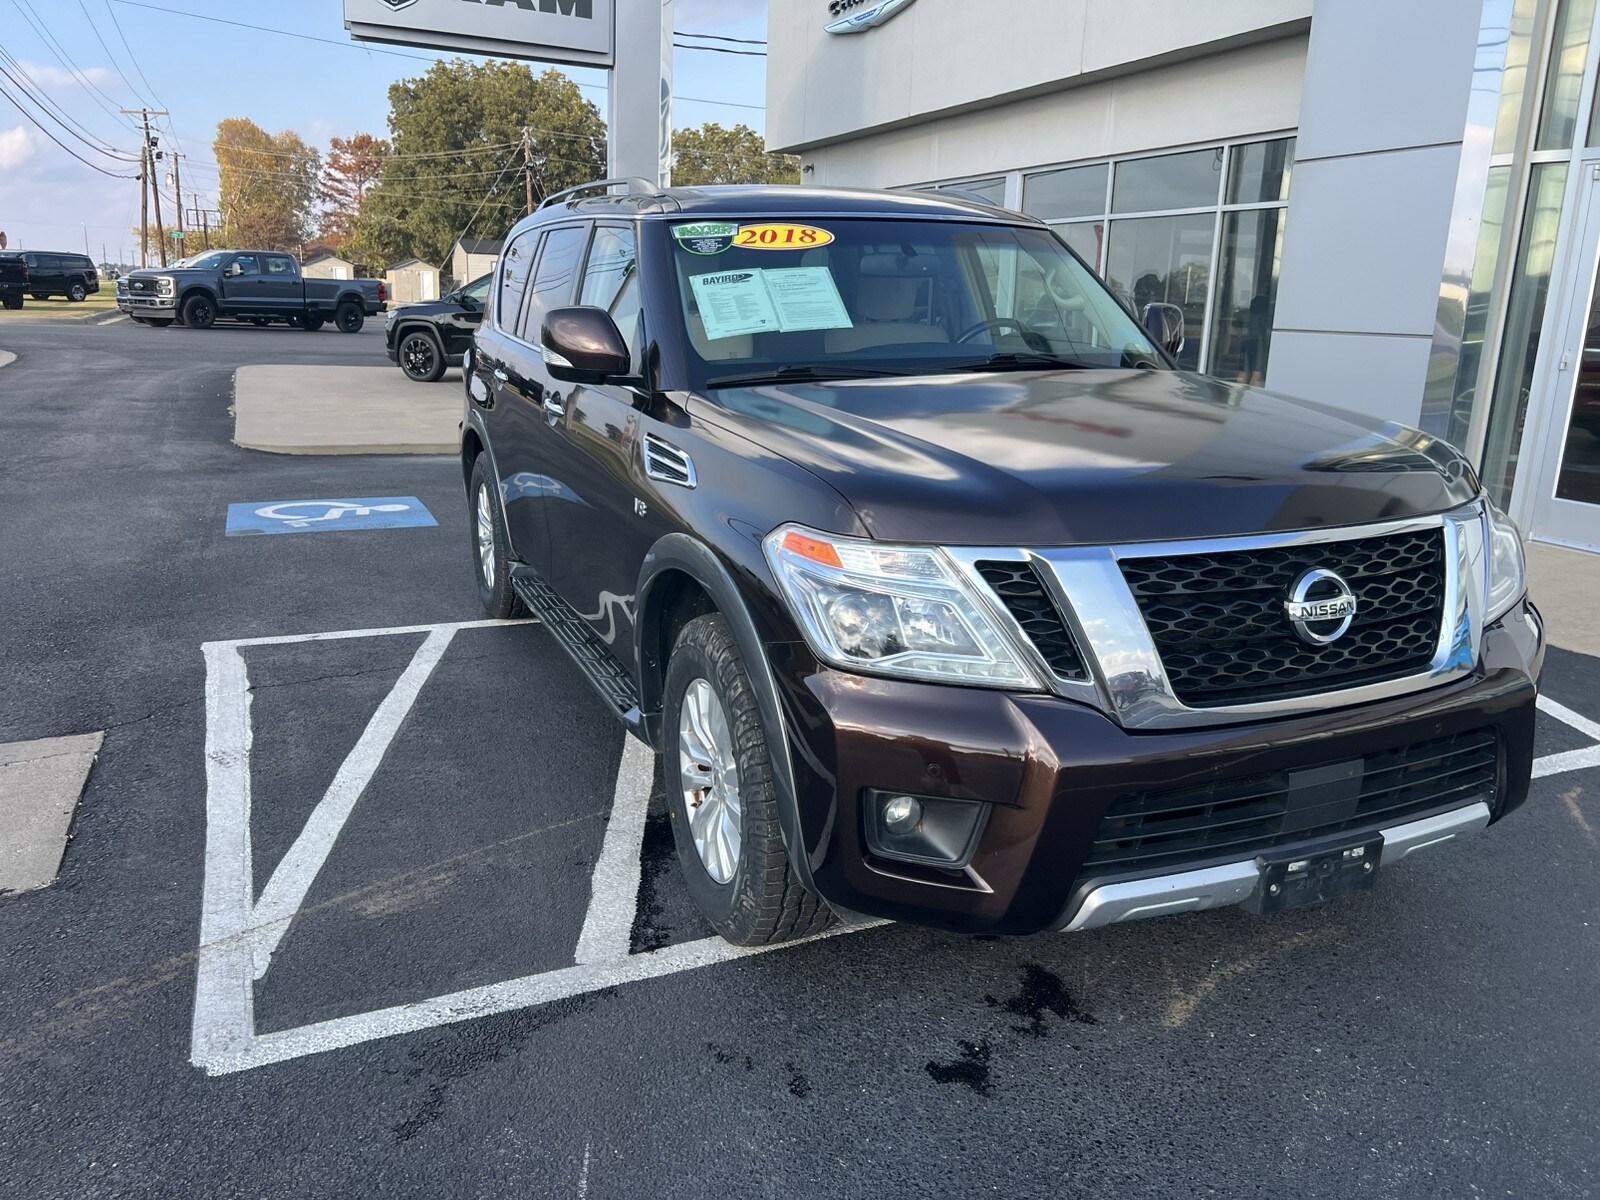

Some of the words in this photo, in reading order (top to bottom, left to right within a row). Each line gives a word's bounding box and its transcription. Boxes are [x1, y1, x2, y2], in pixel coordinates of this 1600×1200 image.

[740, 228, 817, 245] 2018
[702, 273, 738, 286] BAYIRD
[1300, 601, 1355, 617] NISSAN
